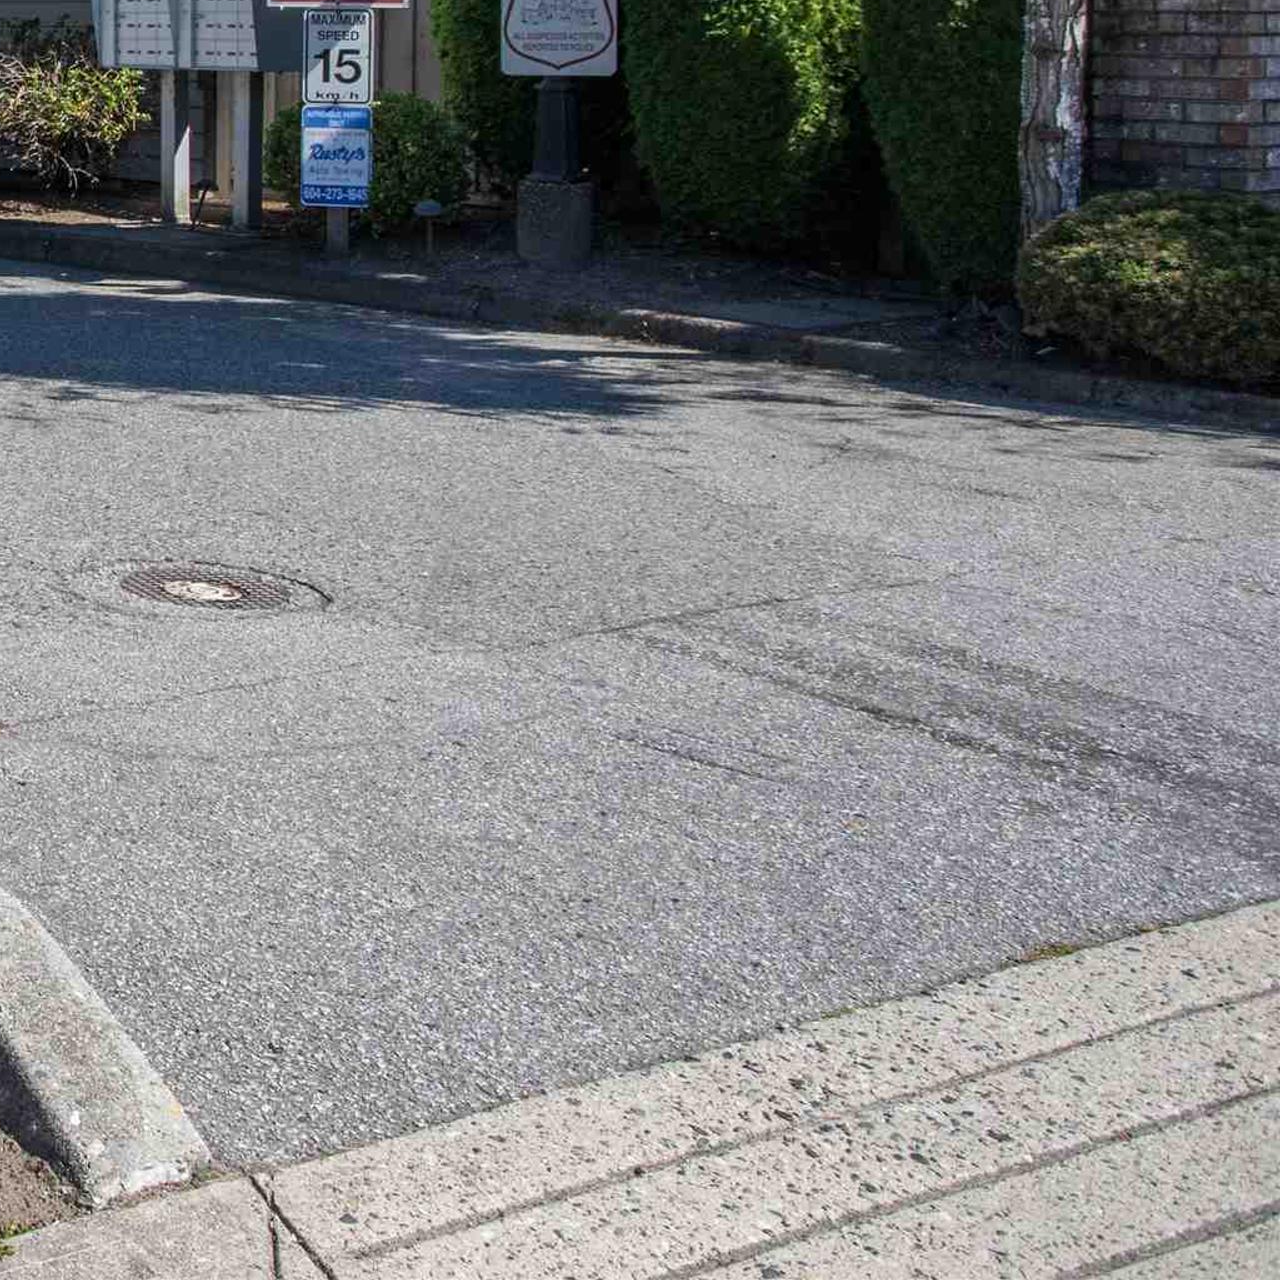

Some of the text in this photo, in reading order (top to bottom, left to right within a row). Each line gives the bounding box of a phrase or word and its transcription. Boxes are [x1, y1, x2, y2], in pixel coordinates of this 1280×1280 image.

[318, 30, 360, 41] SPEED
[313, 48, 362, 85] 15
[308, 143, 365, 165] Rusty's
